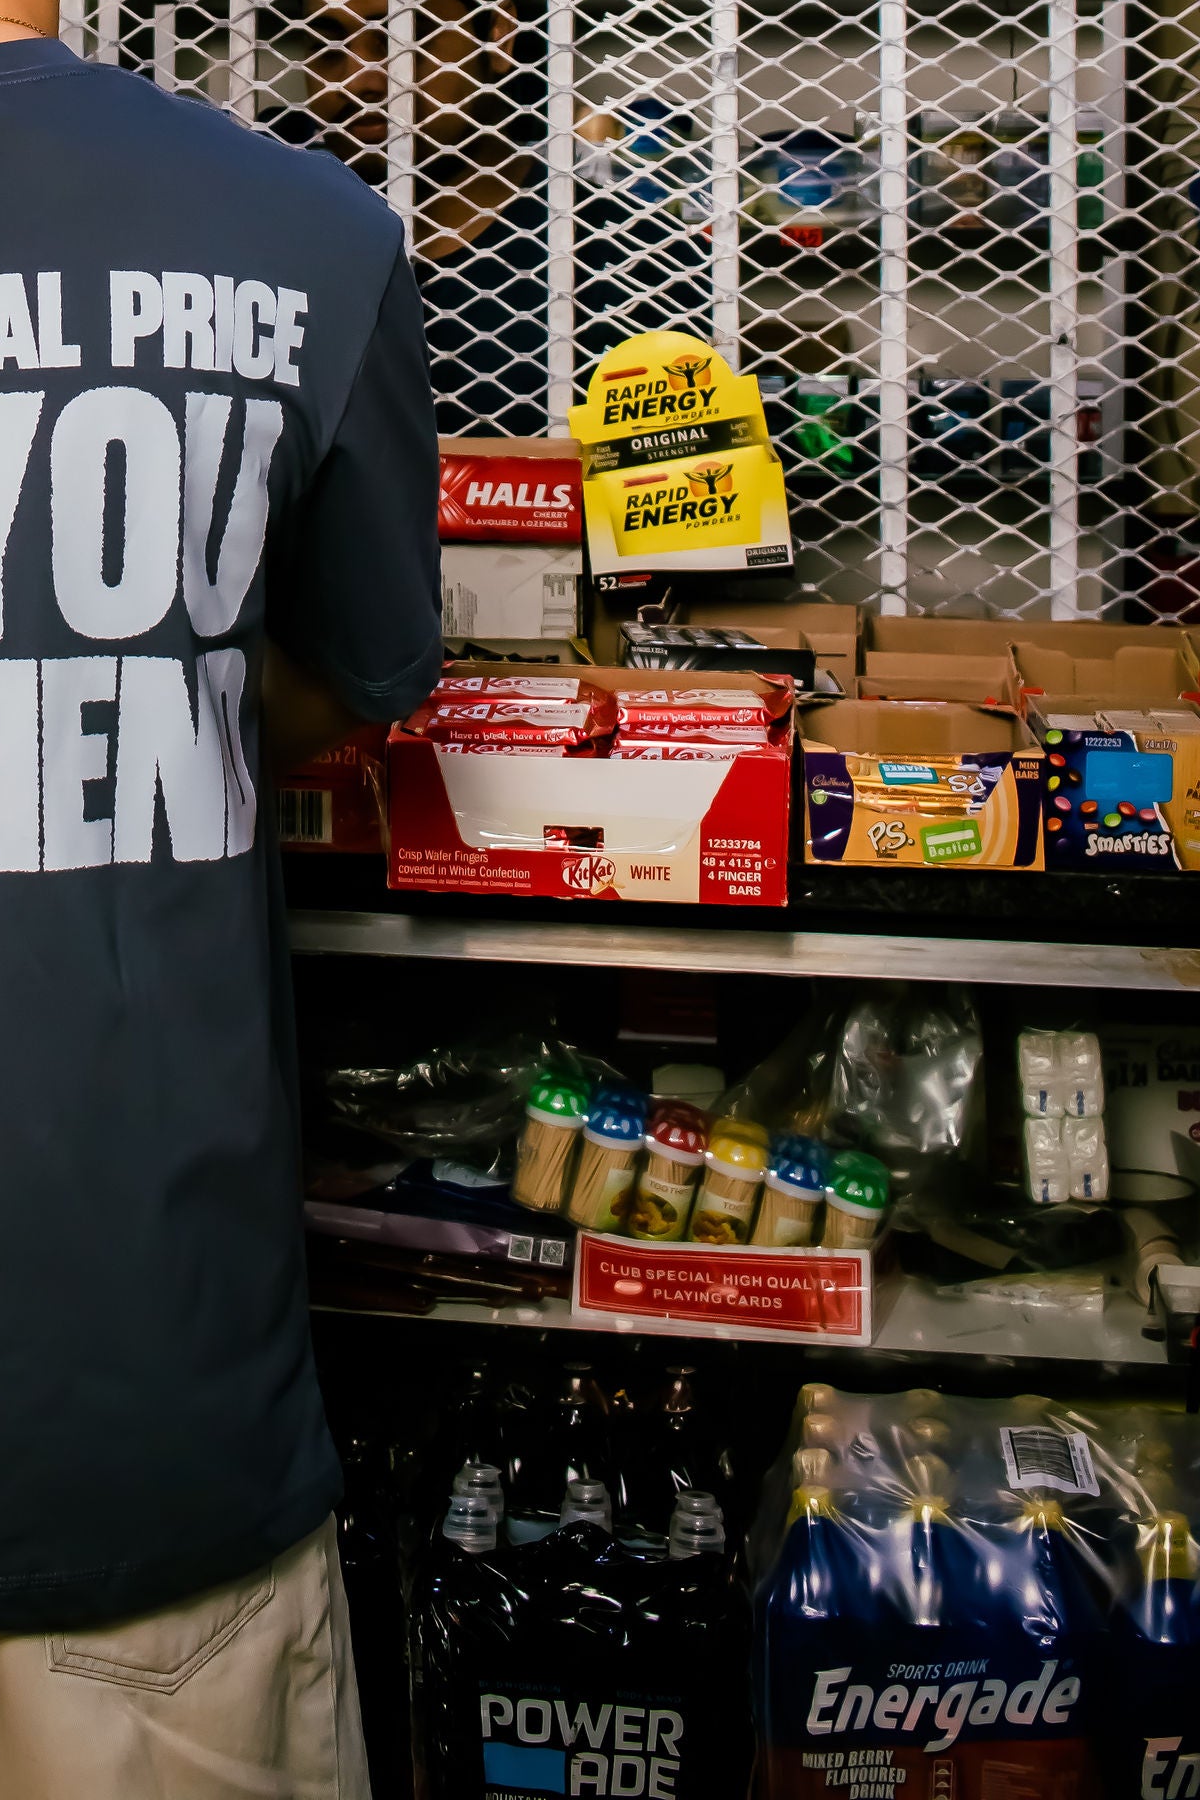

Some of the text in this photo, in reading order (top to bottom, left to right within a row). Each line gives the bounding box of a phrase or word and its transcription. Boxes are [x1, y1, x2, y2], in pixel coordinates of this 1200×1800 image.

[109, 269, 309, 388] PRICE
[605, 379, 669, 404] RAPID
[603, 386, 718, 426] ENERGY
[664, 406, 720, 423] POWDERS
[630, 426, 709, 451] ORIGINAL
[647, 445, 698, 461] STRENGTH
[465, 481, 572, 508] HALLS
[626, 486, 690, 510] RAPID
[533, 511, 568, 519] CHERRY
[623, 493, 739, 532] ENERGY
[685, 513, 742, 529] POWDERS
[465, 517, 568, 529] FLAVOURED LOZENGES
[600, 576, 618, 591] 52
[638, 712, 661, 722] Have
[701, 712, 723, 722] have
[450, 730, 473, 741] Have
[513, 731, 535, 742] have
[1018, 760, 1040, 770] MINI
[1015, 769, 1040, 780] BARS
[707, 838, 762, 850] 12333784
[398, 847, 489, 865] Crisp Wafer Fingers
[702, 856, 716, 867] 48
[728, 857, 752, 869] 41.5
[754, 860, 762, 871] g
[398, 863, 531, 880] covered in White Confection
[568, 856, 614, 888] KitKat
[630, 864, 672, 881] WHITE
[707, 870, 762, 883] 4 FINGER
[728, 885, 762, 896] BARS
[599, 1260, 837, 1291] CLUB SPECIAL HIGH QUALTY
[653, 1288, 783, 1309] PLAYING CARDS
[886, 1658, 990, 1681] SPORTS DRINK
[806, 1659, 1082, 1753] Energade
[480, 1693, 685, 1757] POWER
[802, 1750, 894, 1769] MIXED BERRY
[570, 1752, 681, 1800] ADE
[825, 1767, 907, 1786] FLAVOURED
[849, 1783, 896, 1800] DRINK
